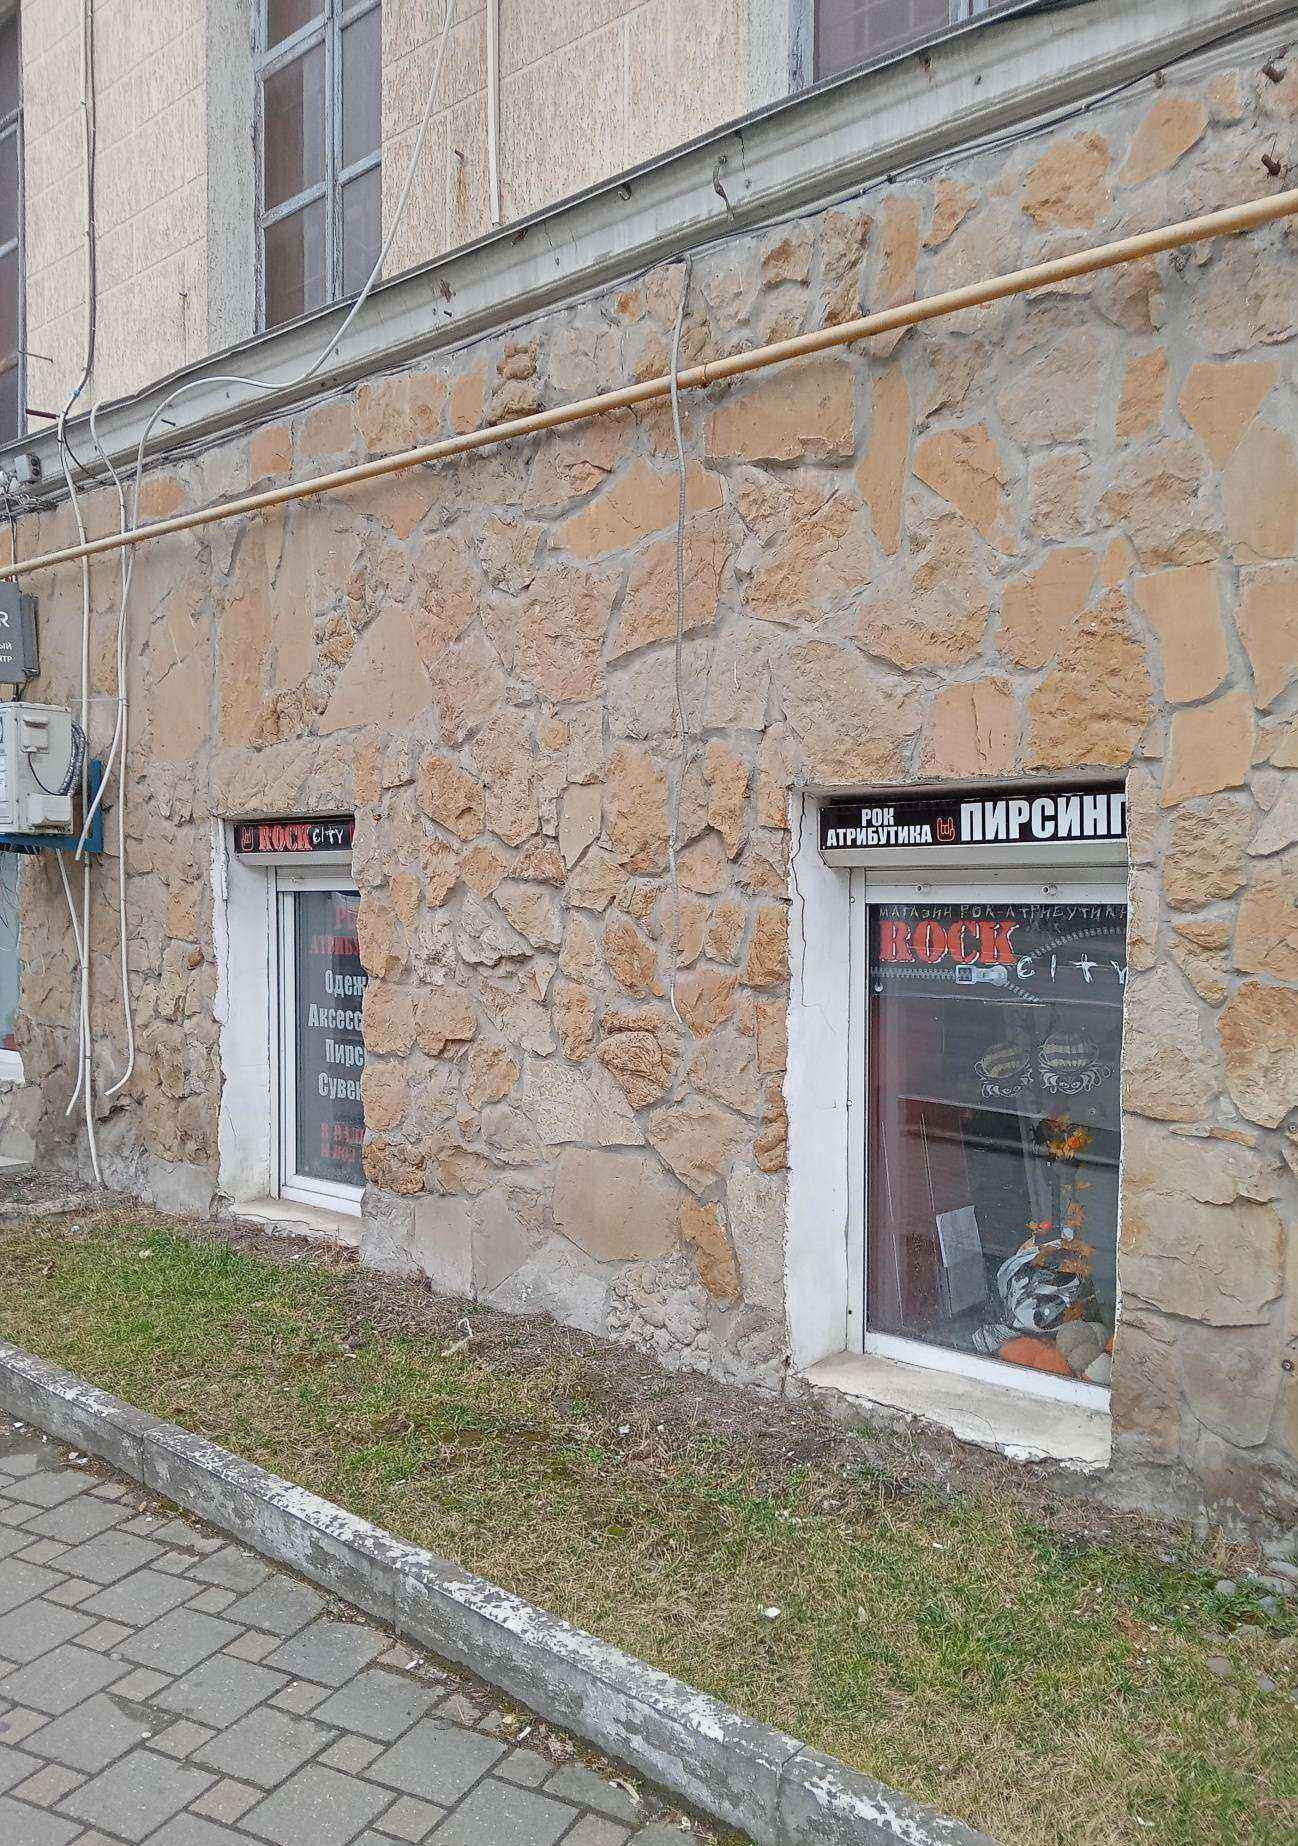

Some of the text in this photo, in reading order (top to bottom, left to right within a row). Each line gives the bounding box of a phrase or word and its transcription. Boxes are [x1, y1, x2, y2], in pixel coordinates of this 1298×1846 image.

[861, 808, 894, 827] РОК
[960, 793, 1127, 842] ПИРСИНГ
[258, 823, 312, 852] ROCK
[826, 824, 933, 847] АТРИБУТИКА
[879, 919, 1020, 966] ROCK
